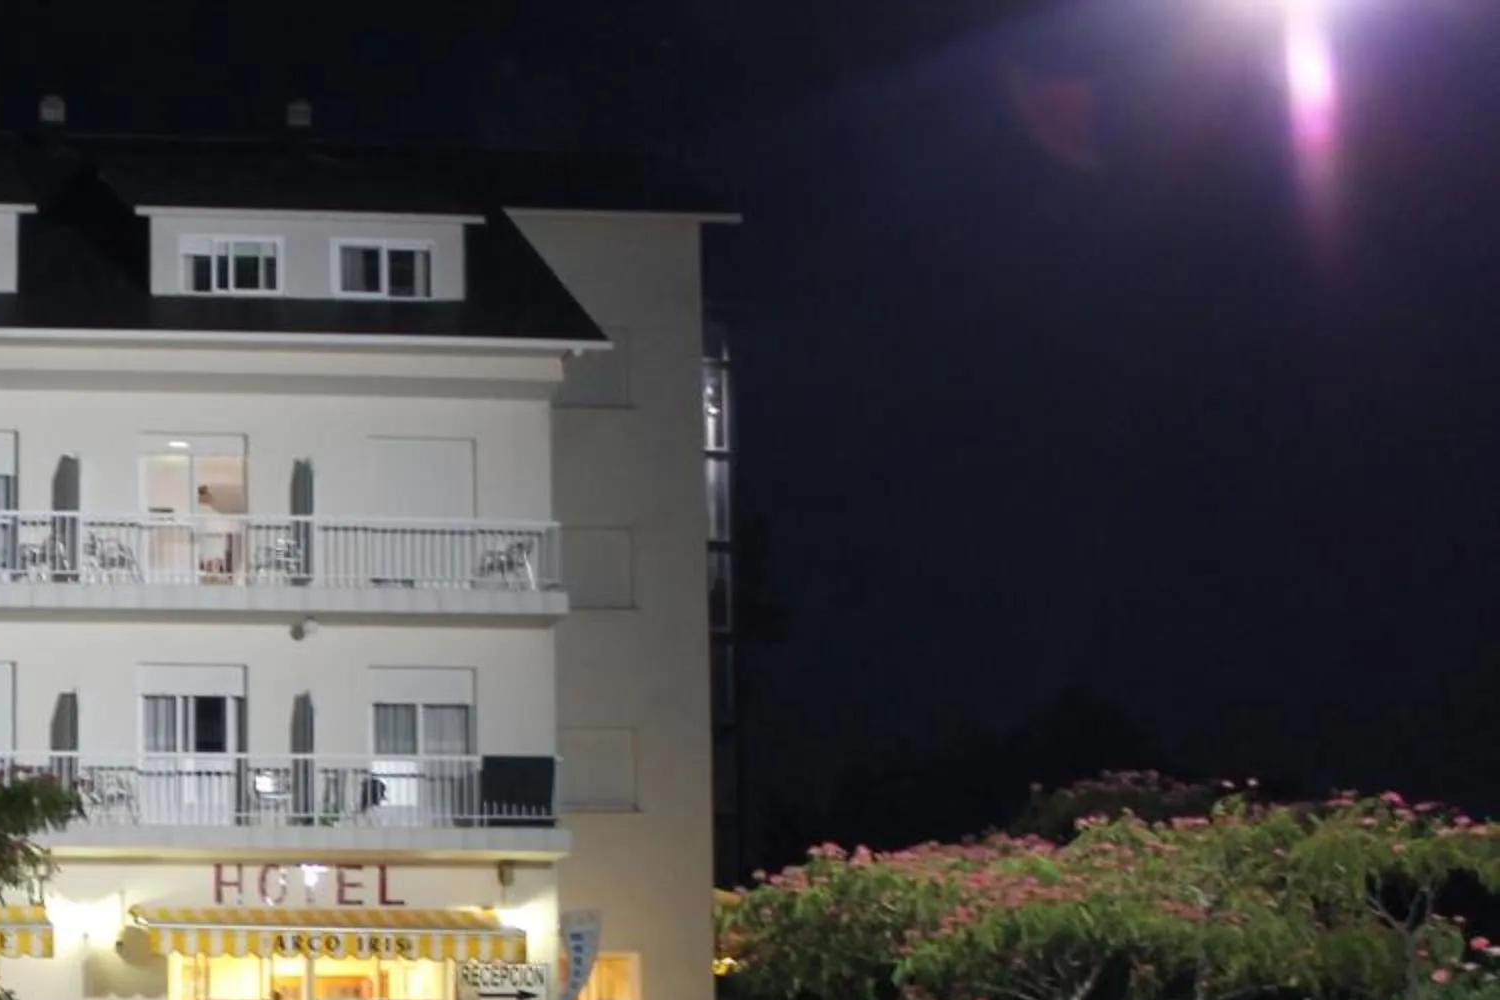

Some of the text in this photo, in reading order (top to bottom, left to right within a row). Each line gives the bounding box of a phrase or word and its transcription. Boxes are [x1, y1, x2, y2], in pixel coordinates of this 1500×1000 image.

[213, 863, 406, 906] HOTEL
[272, 934, 413, 955] ARCO IRIS
